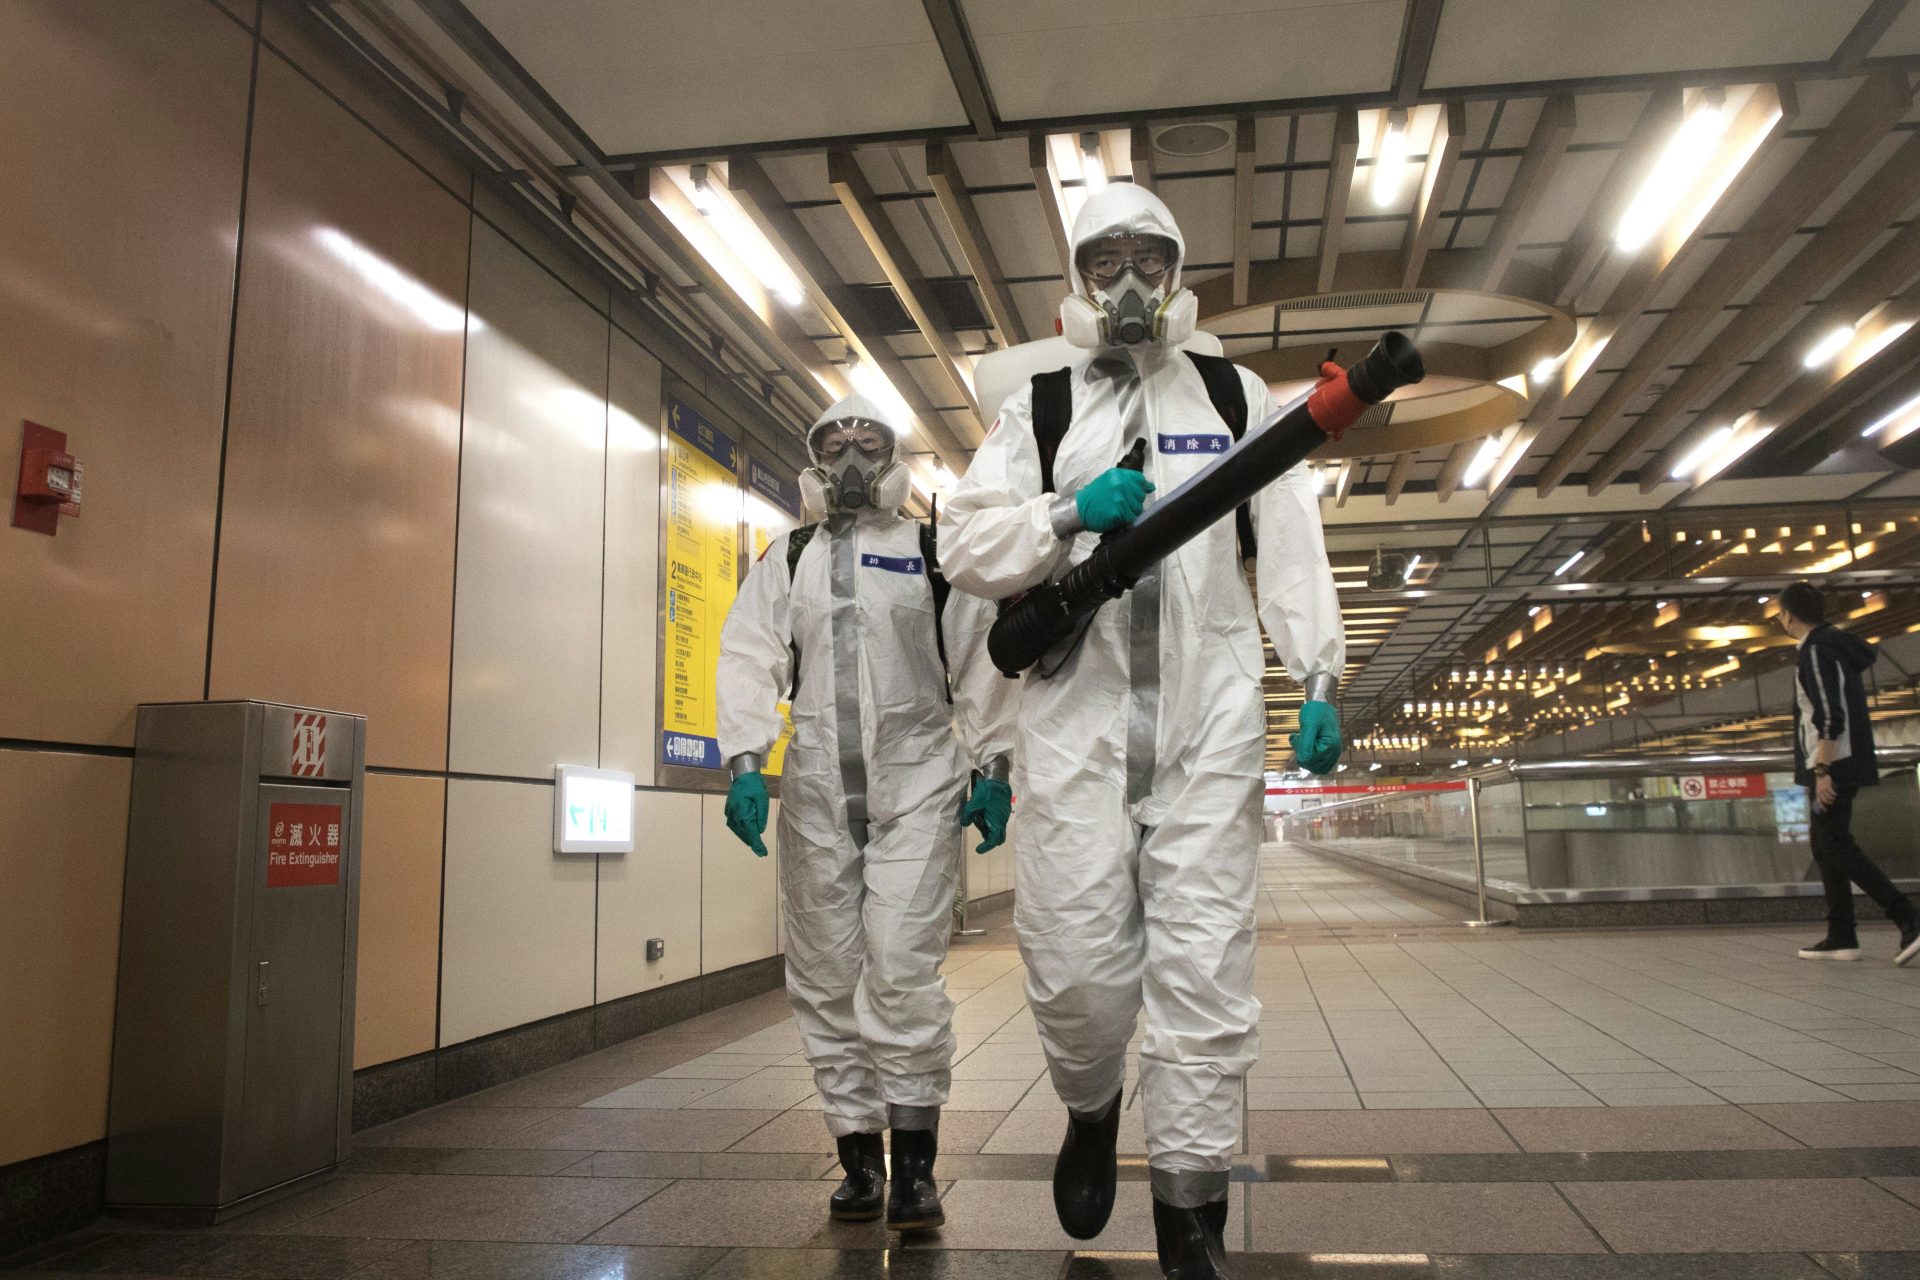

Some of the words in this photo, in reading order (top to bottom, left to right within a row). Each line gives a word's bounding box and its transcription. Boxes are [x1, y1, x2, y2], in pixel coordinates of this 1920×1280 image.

[1164, 438, 1221, 451] 消除兵
[671, 560, 677, 580] 2
[289, 823, 340, 847] 滅火器
[269, 851, 287, 865] Fire
[289, 851, 339, 868] Extinguisher
